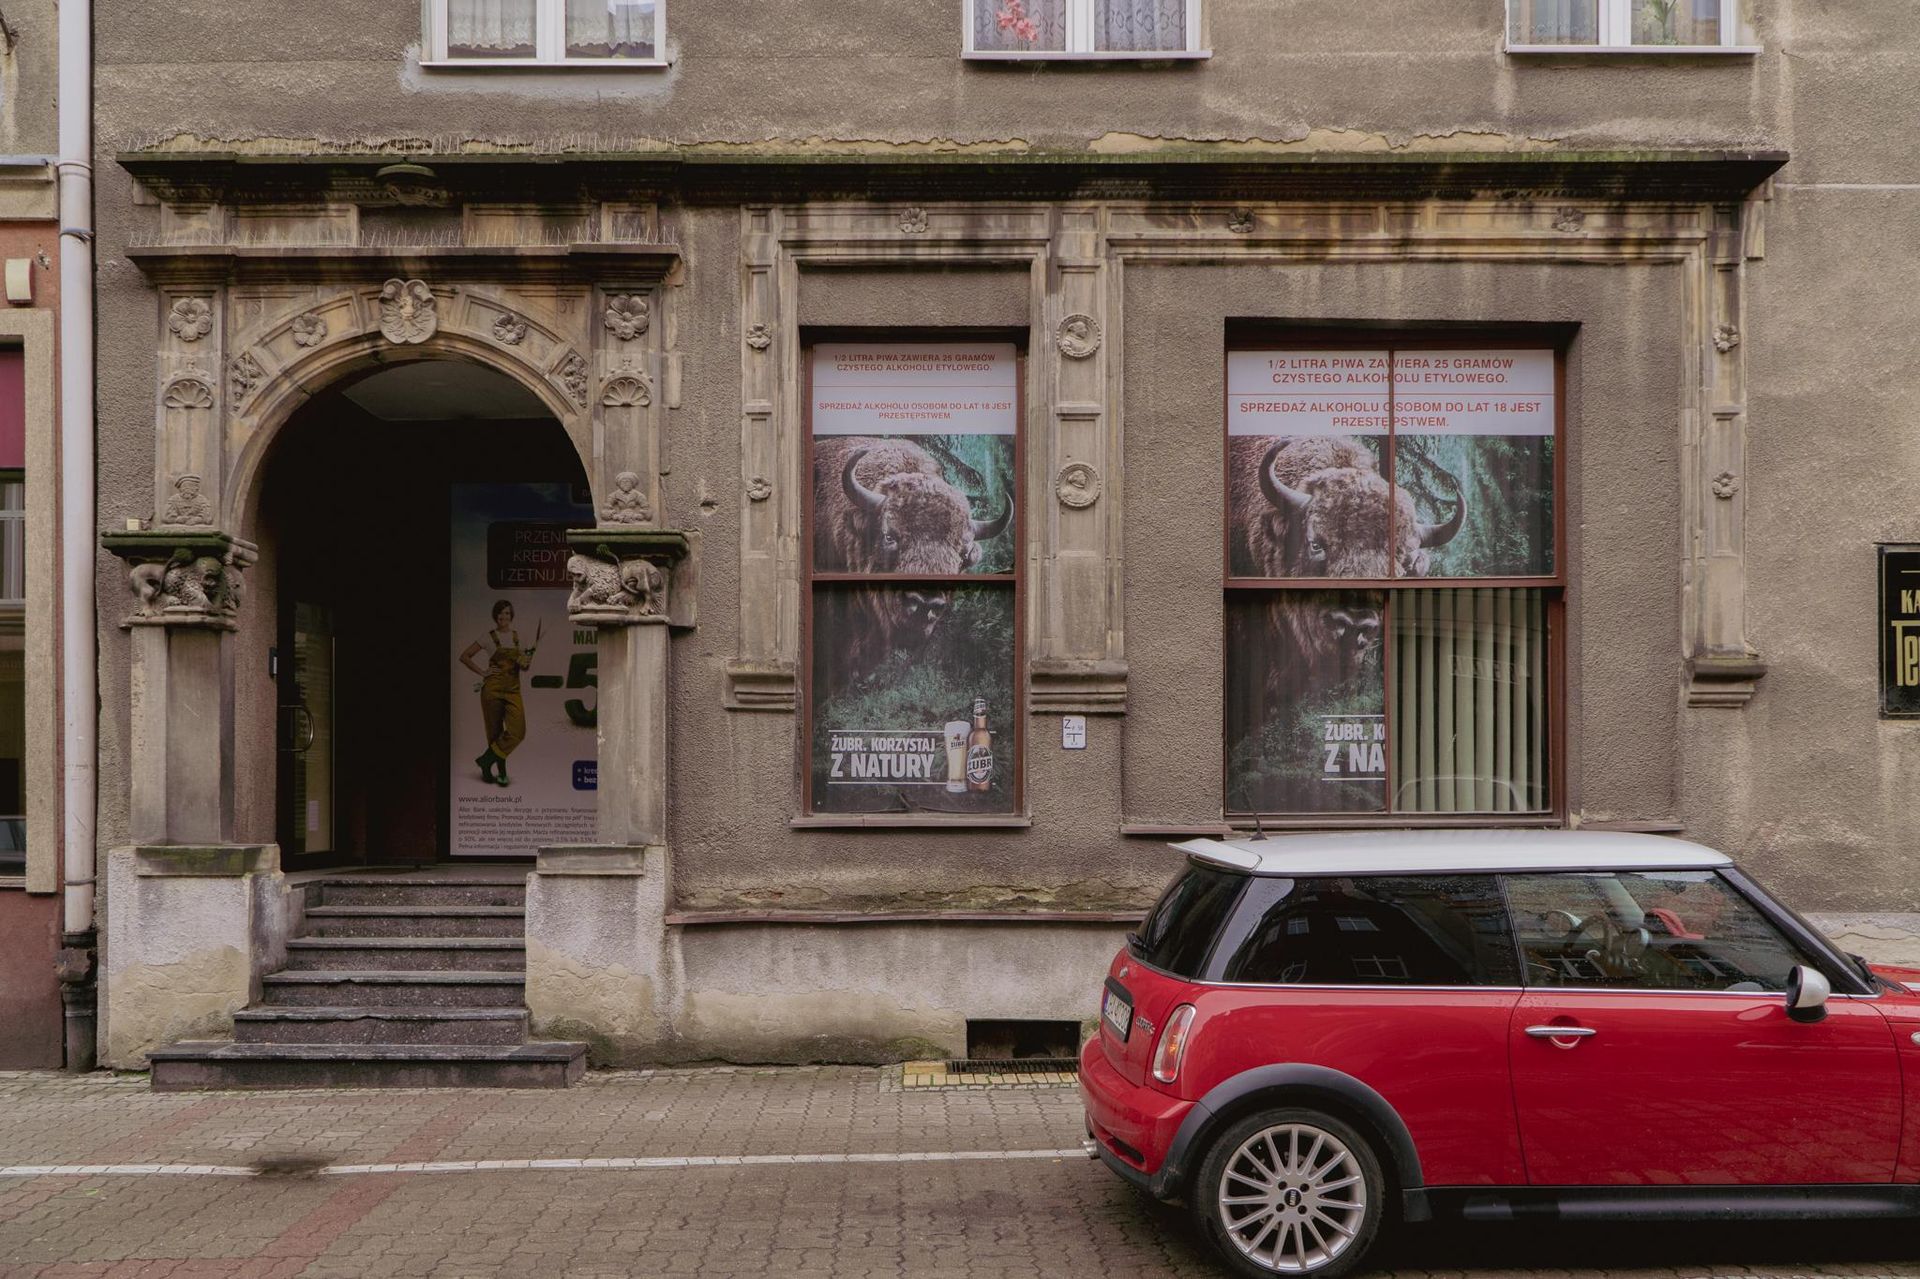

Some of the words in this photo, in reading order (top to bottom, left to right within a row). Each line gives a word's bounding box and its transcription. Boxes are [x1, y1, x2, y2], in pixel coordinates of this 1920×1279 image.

[849, 353, 873, 362] LITRA
[876, 353, 898, 362] PIWA
[900, 353, 940, 362] ZAWIERA
[942, 353, 952, 362] 25
[955, 352, 995, 362] GRAMÓW
[1267, 358, 1286, 369] 1/2
[1290, 358, 1328, 369] LITRA
[1331, 358, 1364, 369] PIWA
[1368, 358, 1430, 369] ZAWIERA
[1434, 358, 1449, 369] 25
[1453, 357, 1514, 369] GRAMÓW
[836, 363, 884, 372] CZYSTEGO
[886, 363, 933, 372] ALKOHOLU
[935, 363, 992, 372] ETYLOWEGO.
[1272, 372, 1342, 383] CZYSTEGO
[1346, 372, 1420, 383] ALKOHOLU
[1424, 372, 1508, 383] ETYLOWEGO.
[818, 401, 862, 410] SPRZEDAŻ
[864, 402, 909, 410] ALKOHOLU
[911, 402, 948, 410] OSOBOM
[949, 402, 962, 410] DO
[964, 402, 978, 410] LAT
[981, 402, 990, 410] 18
[992, 402, 1011, 410] JEST
[1240, 401, 1307, 413] SPRZEDAŻ
[1310, 402, 1379, 413] ALKOHOLU
[1383, 402, 1442, 413] OSOBOM
[1445, 402, 1463, 413] DO
[1467, 402, 1489, 413] LAT
[1493, 402, 1507, 413] 18
[1510, 402, 1541, 413] JEST
[1332, 416, 1449, 429] PRZESTĘPSTWEM.
[514, 529, 568, 544] PRZENI
[1891, 620, 1920, 687] Te
[1324, 721, 1368, 741] ŻUBR.
[831, 734, 867, 751] ŻUBR.
[871, 737, 935, 751] KORZYSTAJ
[1324, 743, 1340, 773] Z
[1350, 743, 1385, 773] NA
[830, 753, 844, 778] Z
[851, 753, 935, 778] NATURY
